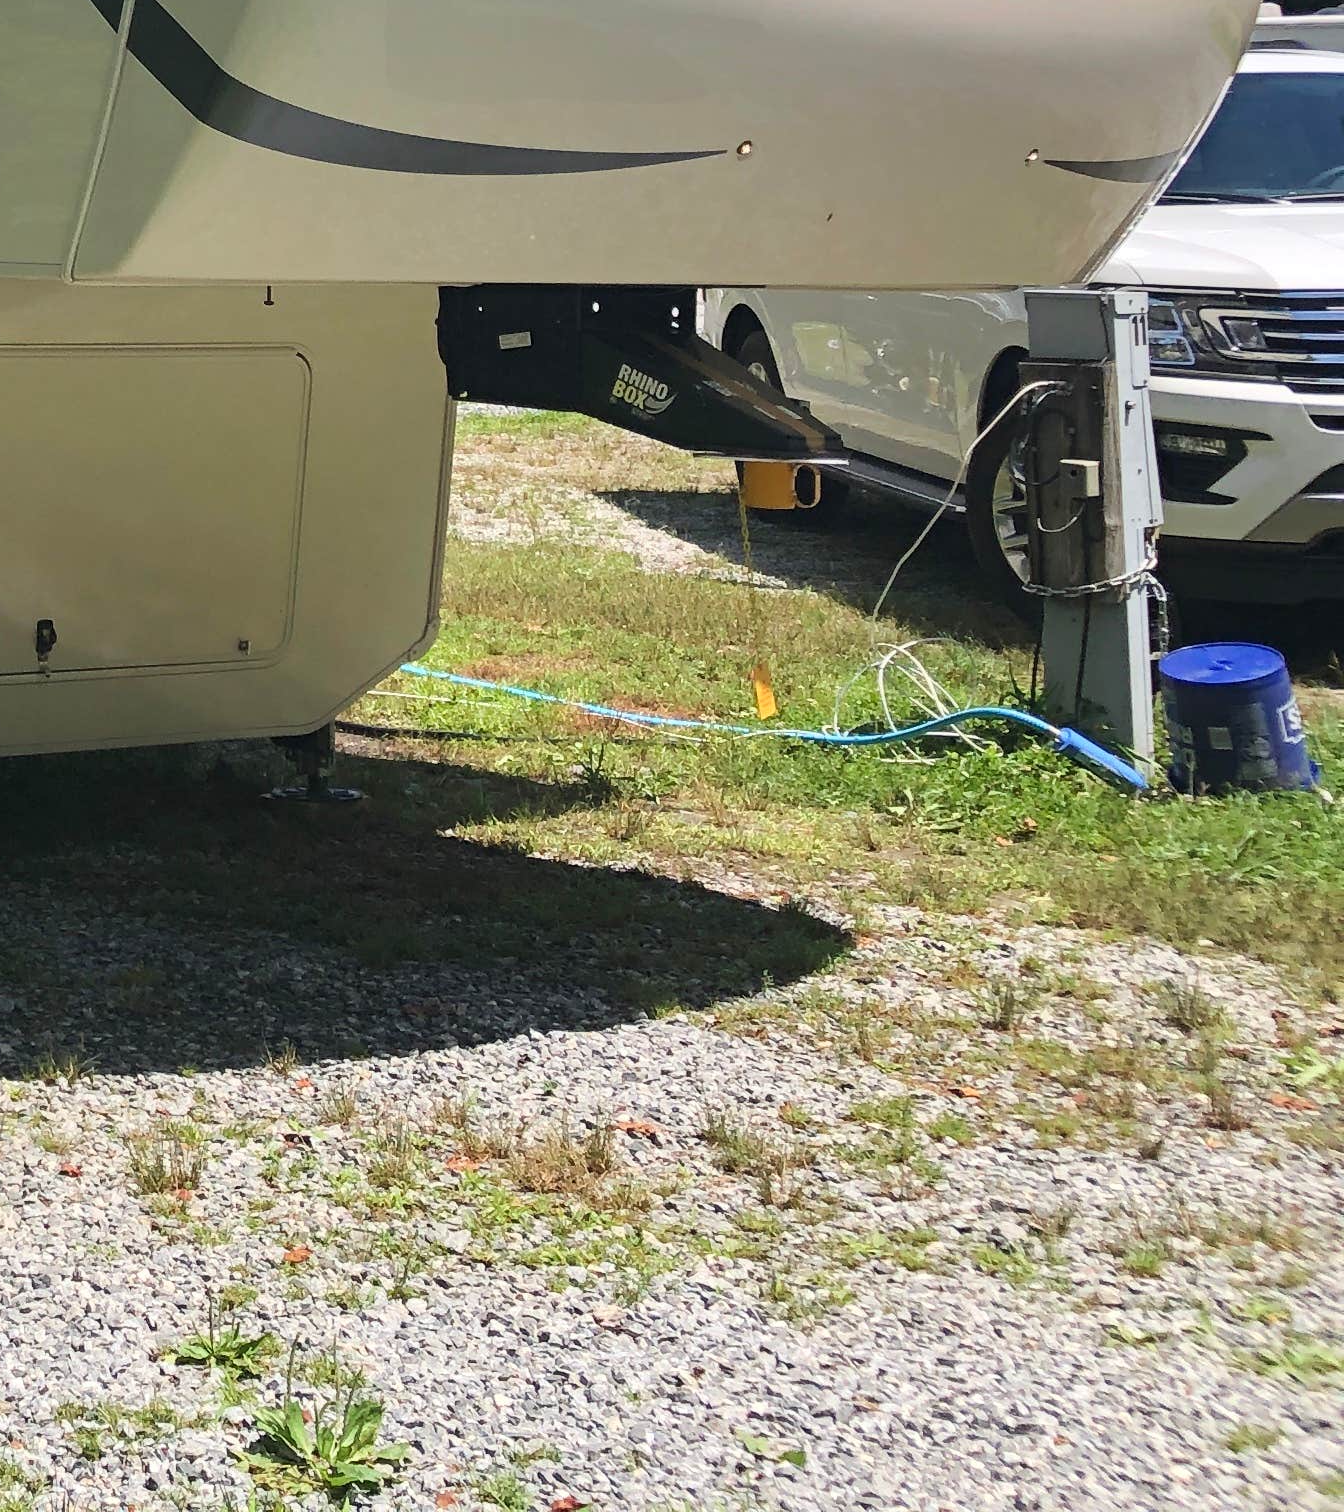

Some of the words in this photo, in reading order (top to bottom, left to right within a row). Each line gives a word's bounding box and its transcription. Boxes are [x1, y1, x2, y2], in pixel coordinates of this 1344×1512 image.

[1132, 315, 1147, 347] 11
[613, 380, 647, 409] BOX
[618, 364, 668, 399] RHINO
